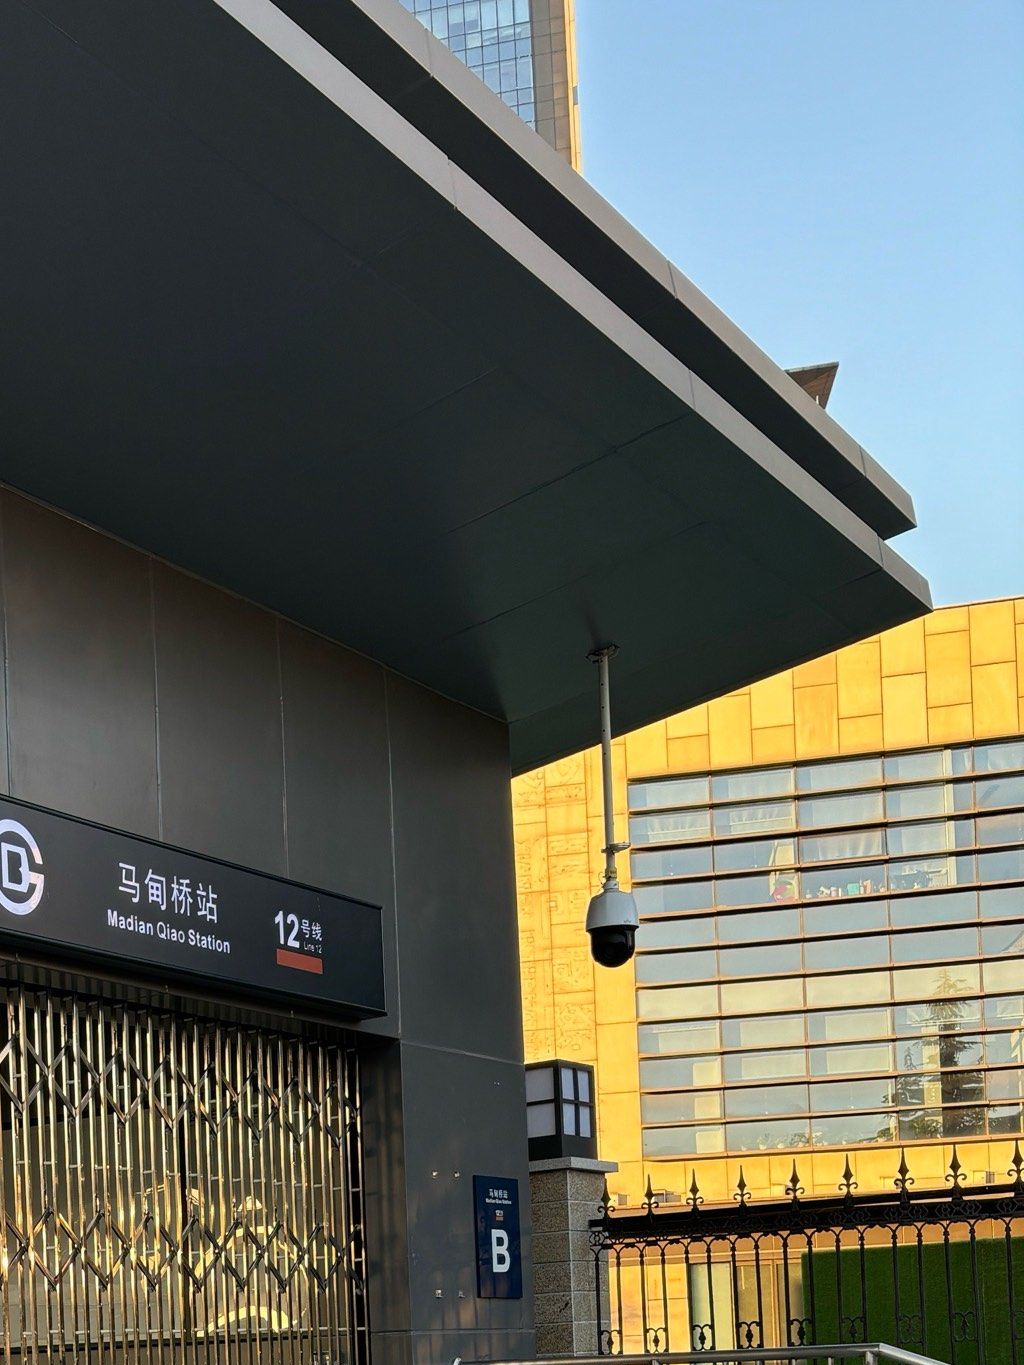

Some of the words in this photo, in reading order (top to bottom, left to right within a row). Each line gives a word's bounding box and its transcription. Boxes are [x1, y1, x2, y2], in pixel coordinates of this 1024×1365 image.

[118, 862, 218, 924] 马甸桥站
[107, 909, 154, 936] Madian
[156, 920, 185, 944] Qiao
[188, 929, 231, 954] Station
[491, 1229, 510, 1273] B
